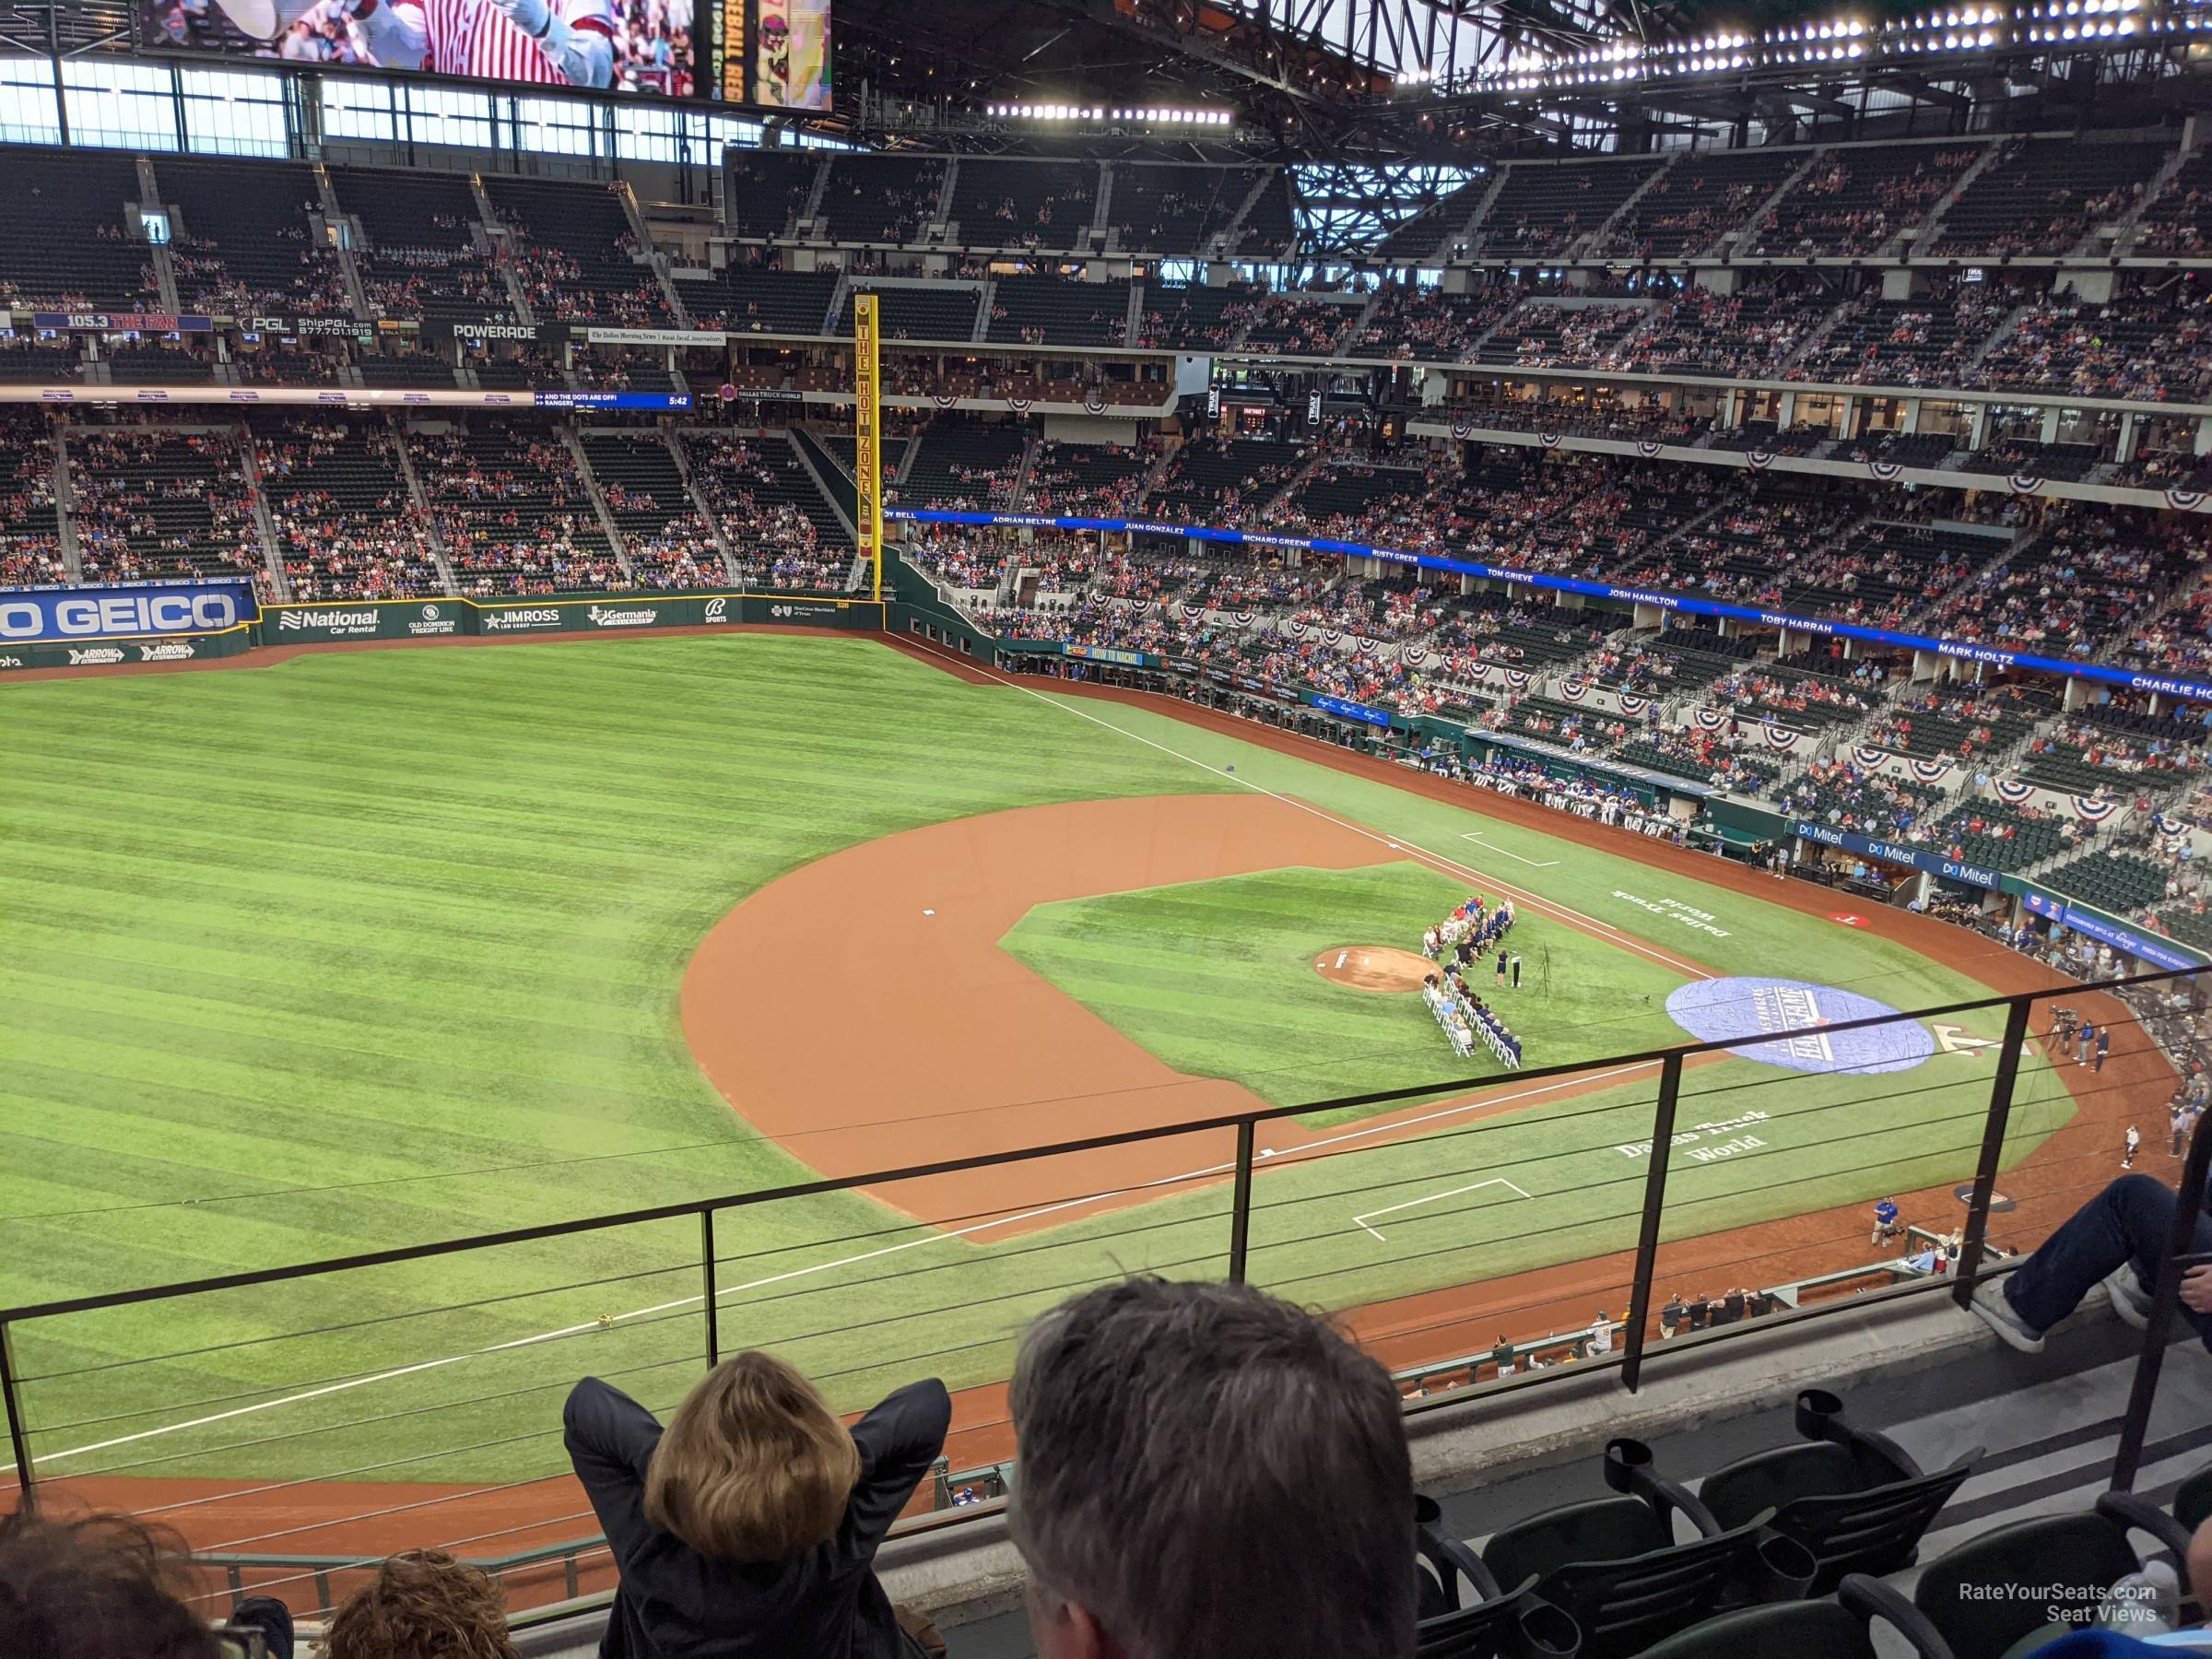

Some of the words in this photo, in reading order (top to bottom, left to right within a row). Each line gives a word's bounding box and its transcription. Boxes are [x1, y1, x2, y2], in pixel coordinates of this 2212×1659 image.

[67, 315, 109, 328] 105.3
[110, 316, 144, 329] THE
[146, 316, 179, 330] FAN
[253, 317, 291, 331] PGL
[298, 318, 371, 328] ShipPGL.com
[299, 327, 372, 336] 877.701.1919
[453, 324, 536, 339] POWERADE
[592, 331, 602, 339] The
[603, 331, 619, 339] Dallas
[619, 332, 642, 340] Morning
[859, 326, 868, 370] THE
[860, 382, 869, 425] HOT
[860, 437, 871, 494] ZONE
[1124, 523, 1144, 532] JUAN
[1242, 535, 1277, 545] RICHARD
[1278, 538, 1312, 548] GREENE
[1372, 549, 1394, 561] RUSTY
[1394, 552, 1418, 563] GREER
[1488, 568, 1504, 579] TOM
[1505, 571, 1534, 582] GRIEVE
[1608, 588, 1630, 601] JOSH
[1632, 592, 1678, 607] HAMILTON
[55, 594, 236, 634] GEICO
[607, 608, 657, 619] Germania
[1760, 614, 1787, 627] TOBY
[1788, 618, 1832, 633] HARRAH
[82, 648, 117, 658] ARROW
[154, 645, 186, 654] ARROW
[1092, 647, 1107, 660] HOW
[1108, 649, 1115, 662] TO
[1938, 644, 1971, 659] MARK
[1974, 651, 2014, 665] HOLTZ
[2132, 677, 2194, 695] CHARLIE
[1814, 828, 1843, 845] Mitel
[1884, 846, 1916, 865] Mitel
[1959, 865, 1994, 886] Mitel
[1694, 1111, 1771, 1135] Truck
[1683, 1135, 1769, 1162] World
